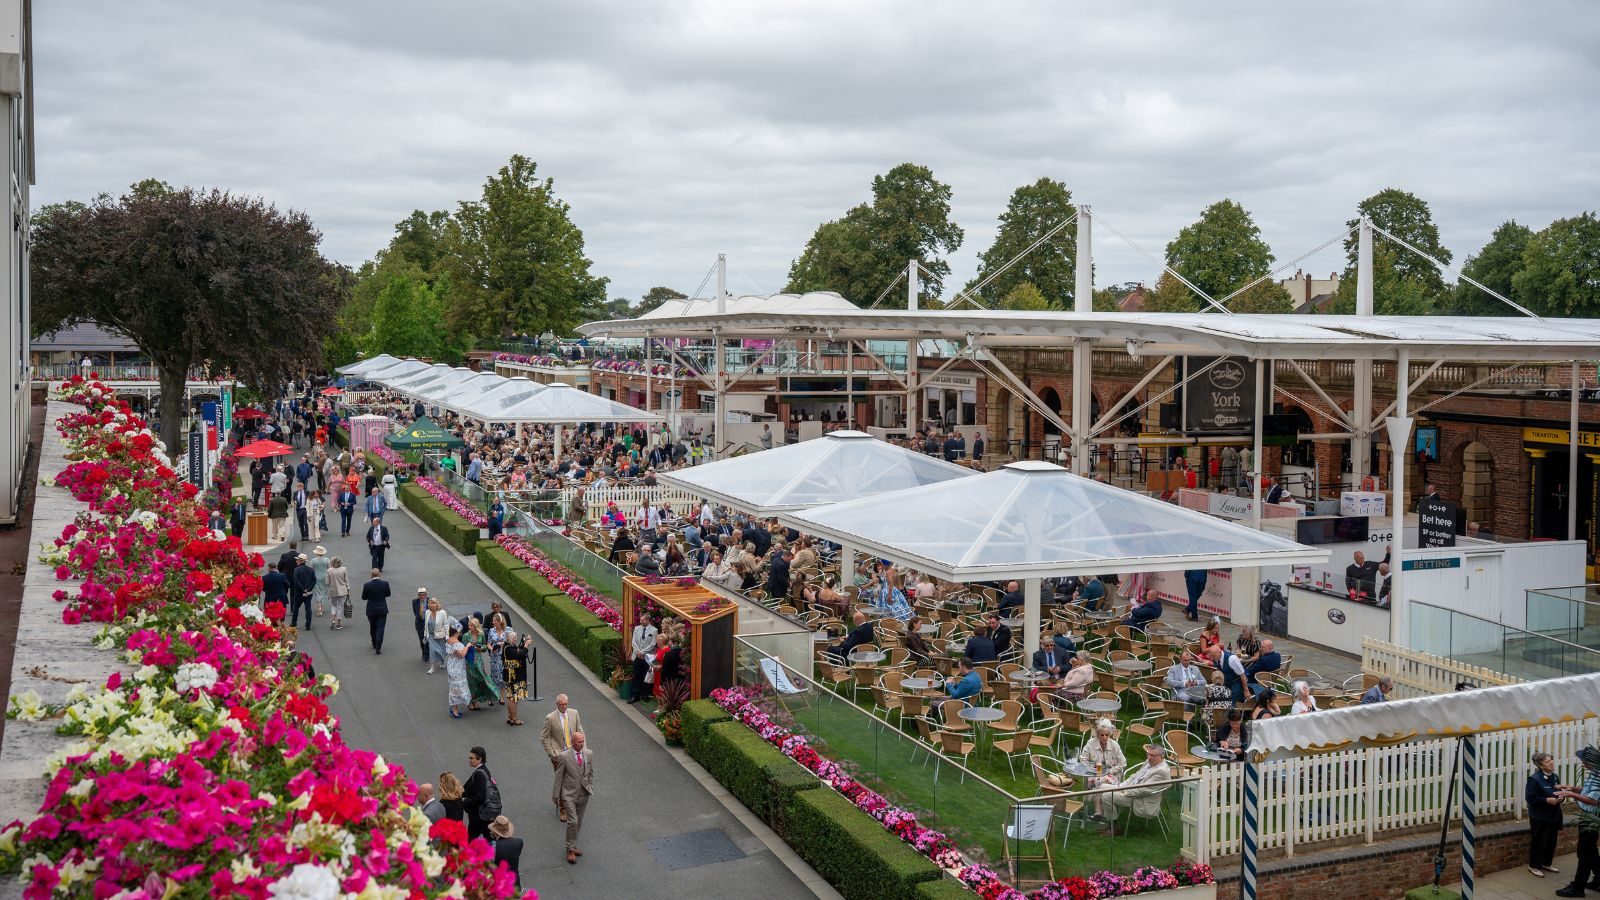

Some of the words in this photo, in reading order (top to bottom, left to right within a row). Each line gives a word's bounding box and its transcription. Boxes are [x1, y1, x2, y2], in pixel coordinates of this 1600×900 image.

[1211, 392, 1240, 406] York
[1422, 514, 1434, 524] Bet
[1436, 516, 1452, 527] here
[1413, 560, 1450, 568] BETTING
